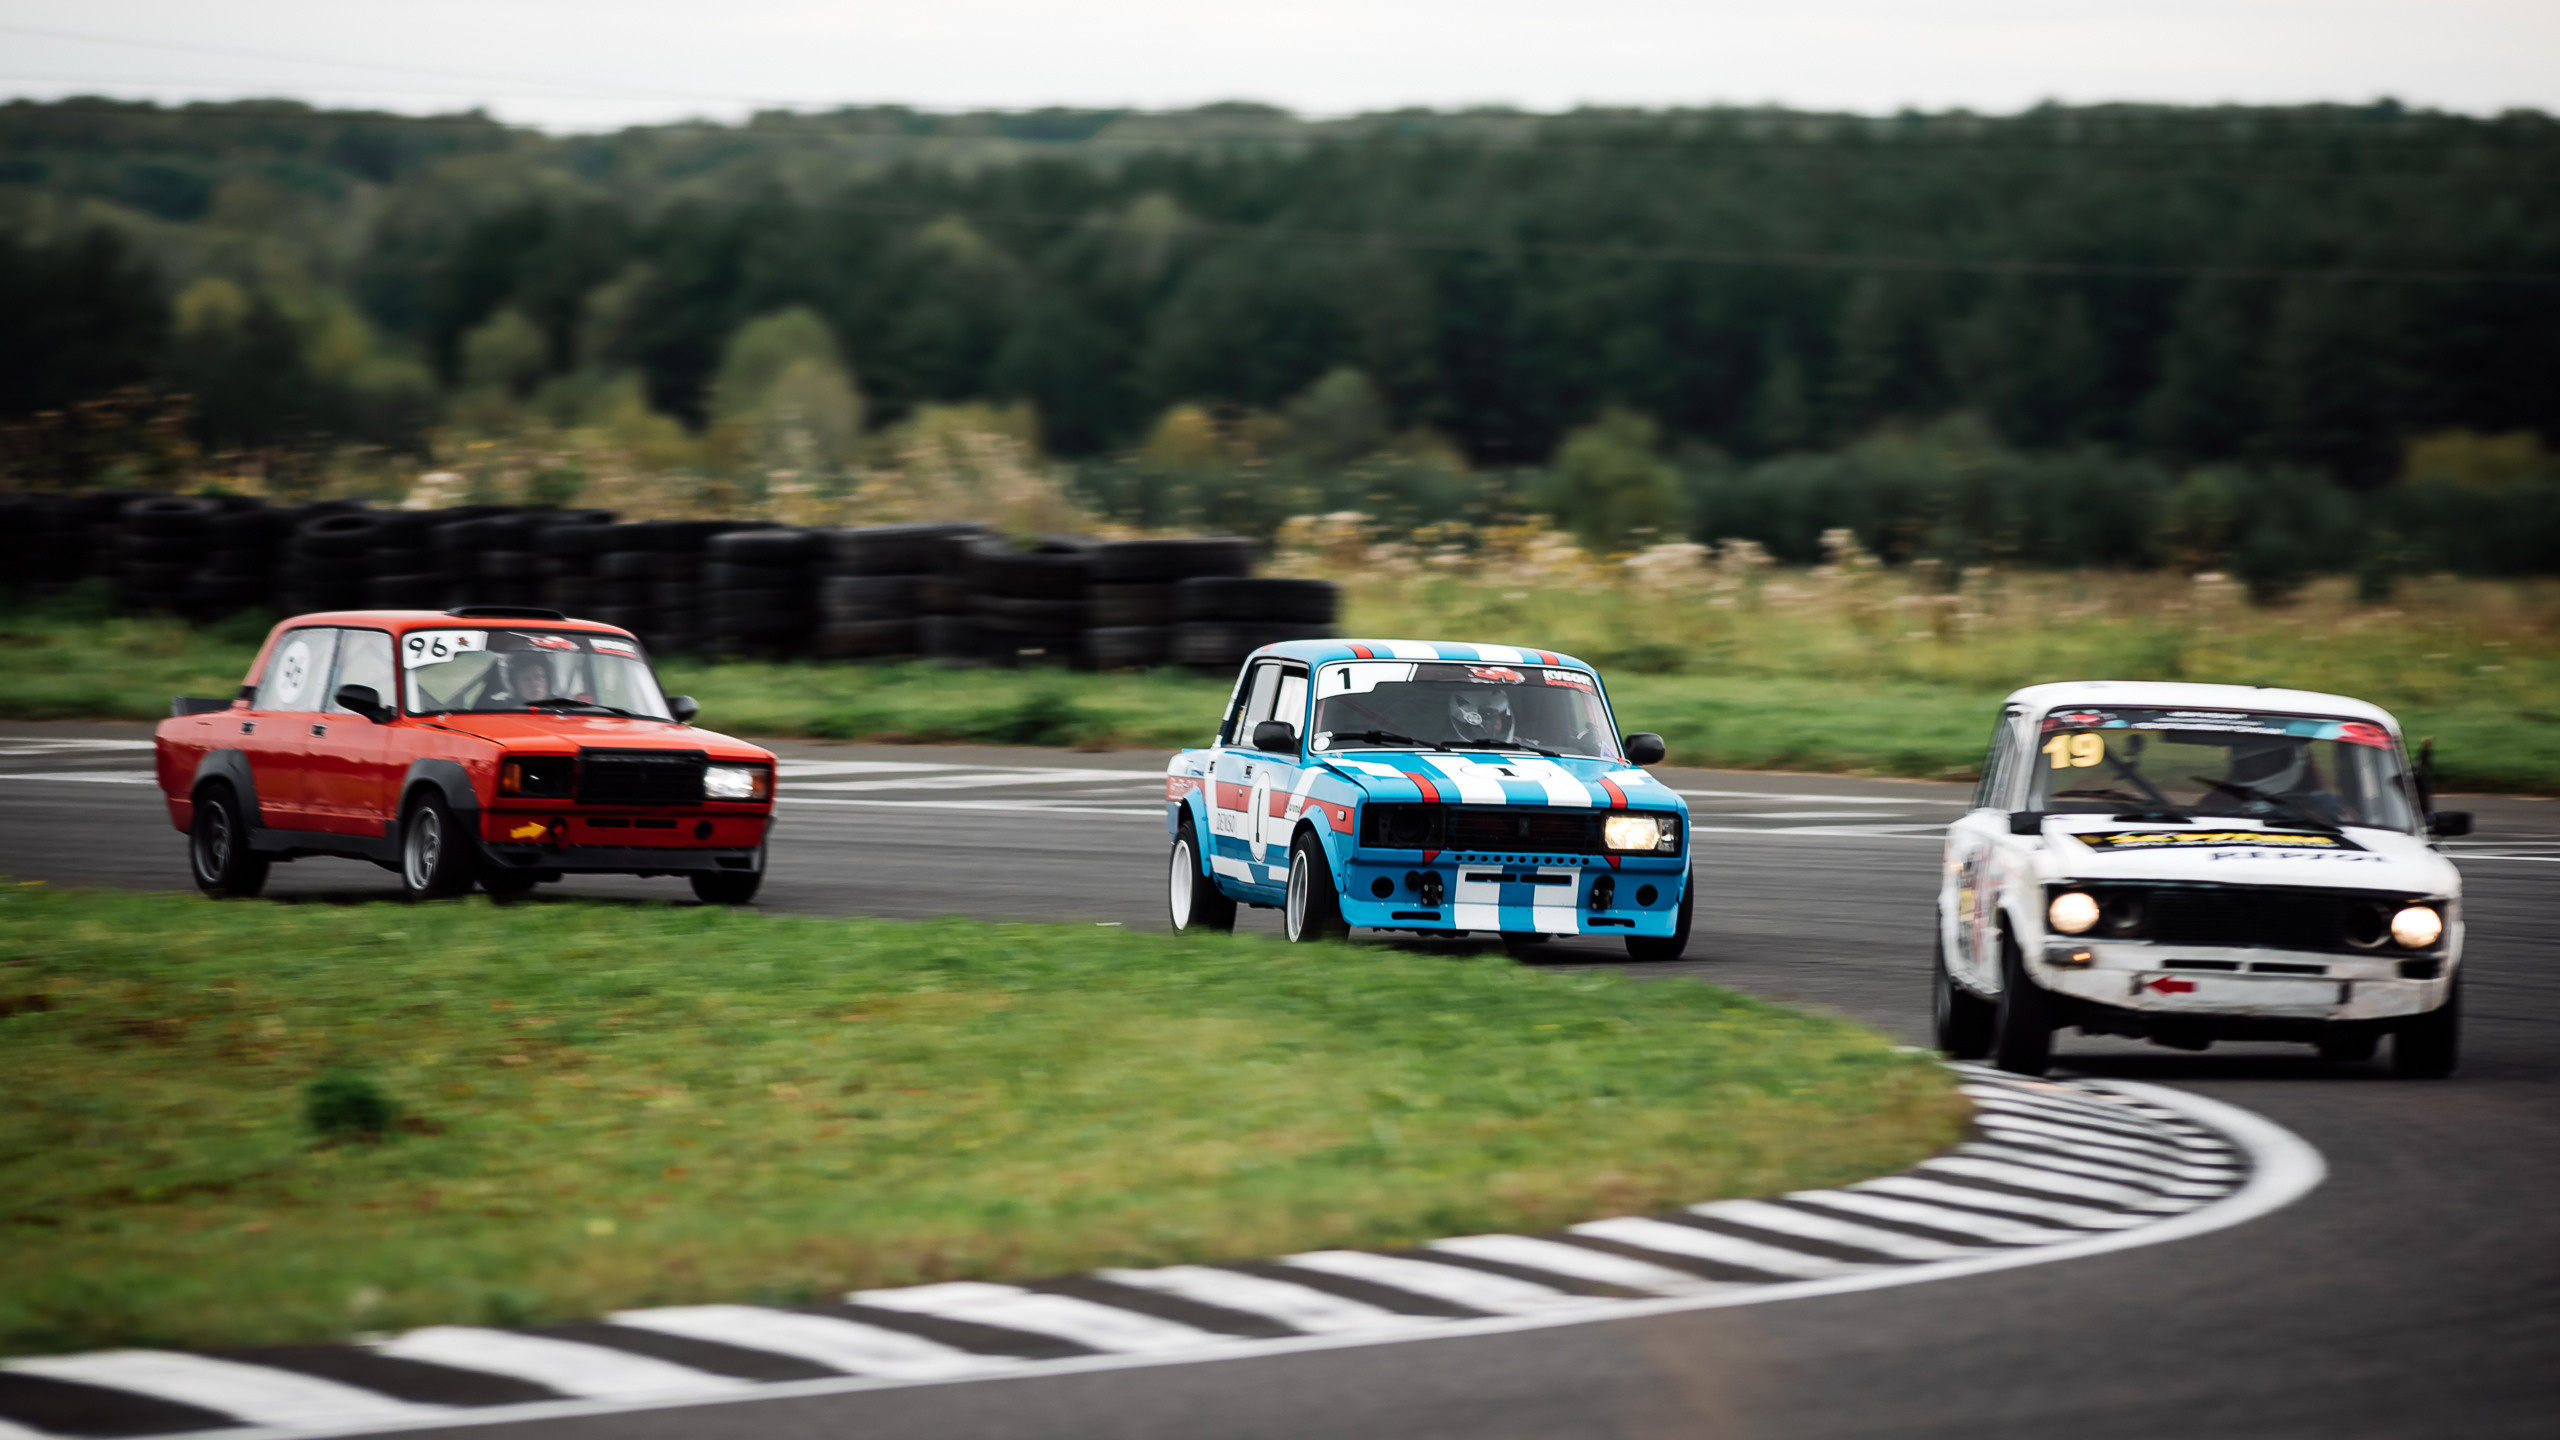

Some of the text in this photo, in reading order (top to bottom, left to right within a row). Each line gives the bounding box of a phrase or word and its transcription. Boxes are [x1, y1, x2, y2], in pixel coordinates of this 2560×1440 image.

[408, 637, 449, 658] 96
[1338, 667, 1351, 690] 1
[2042, 733, 2104, 774] 19
[1256, 788, 1263, 843] 1
